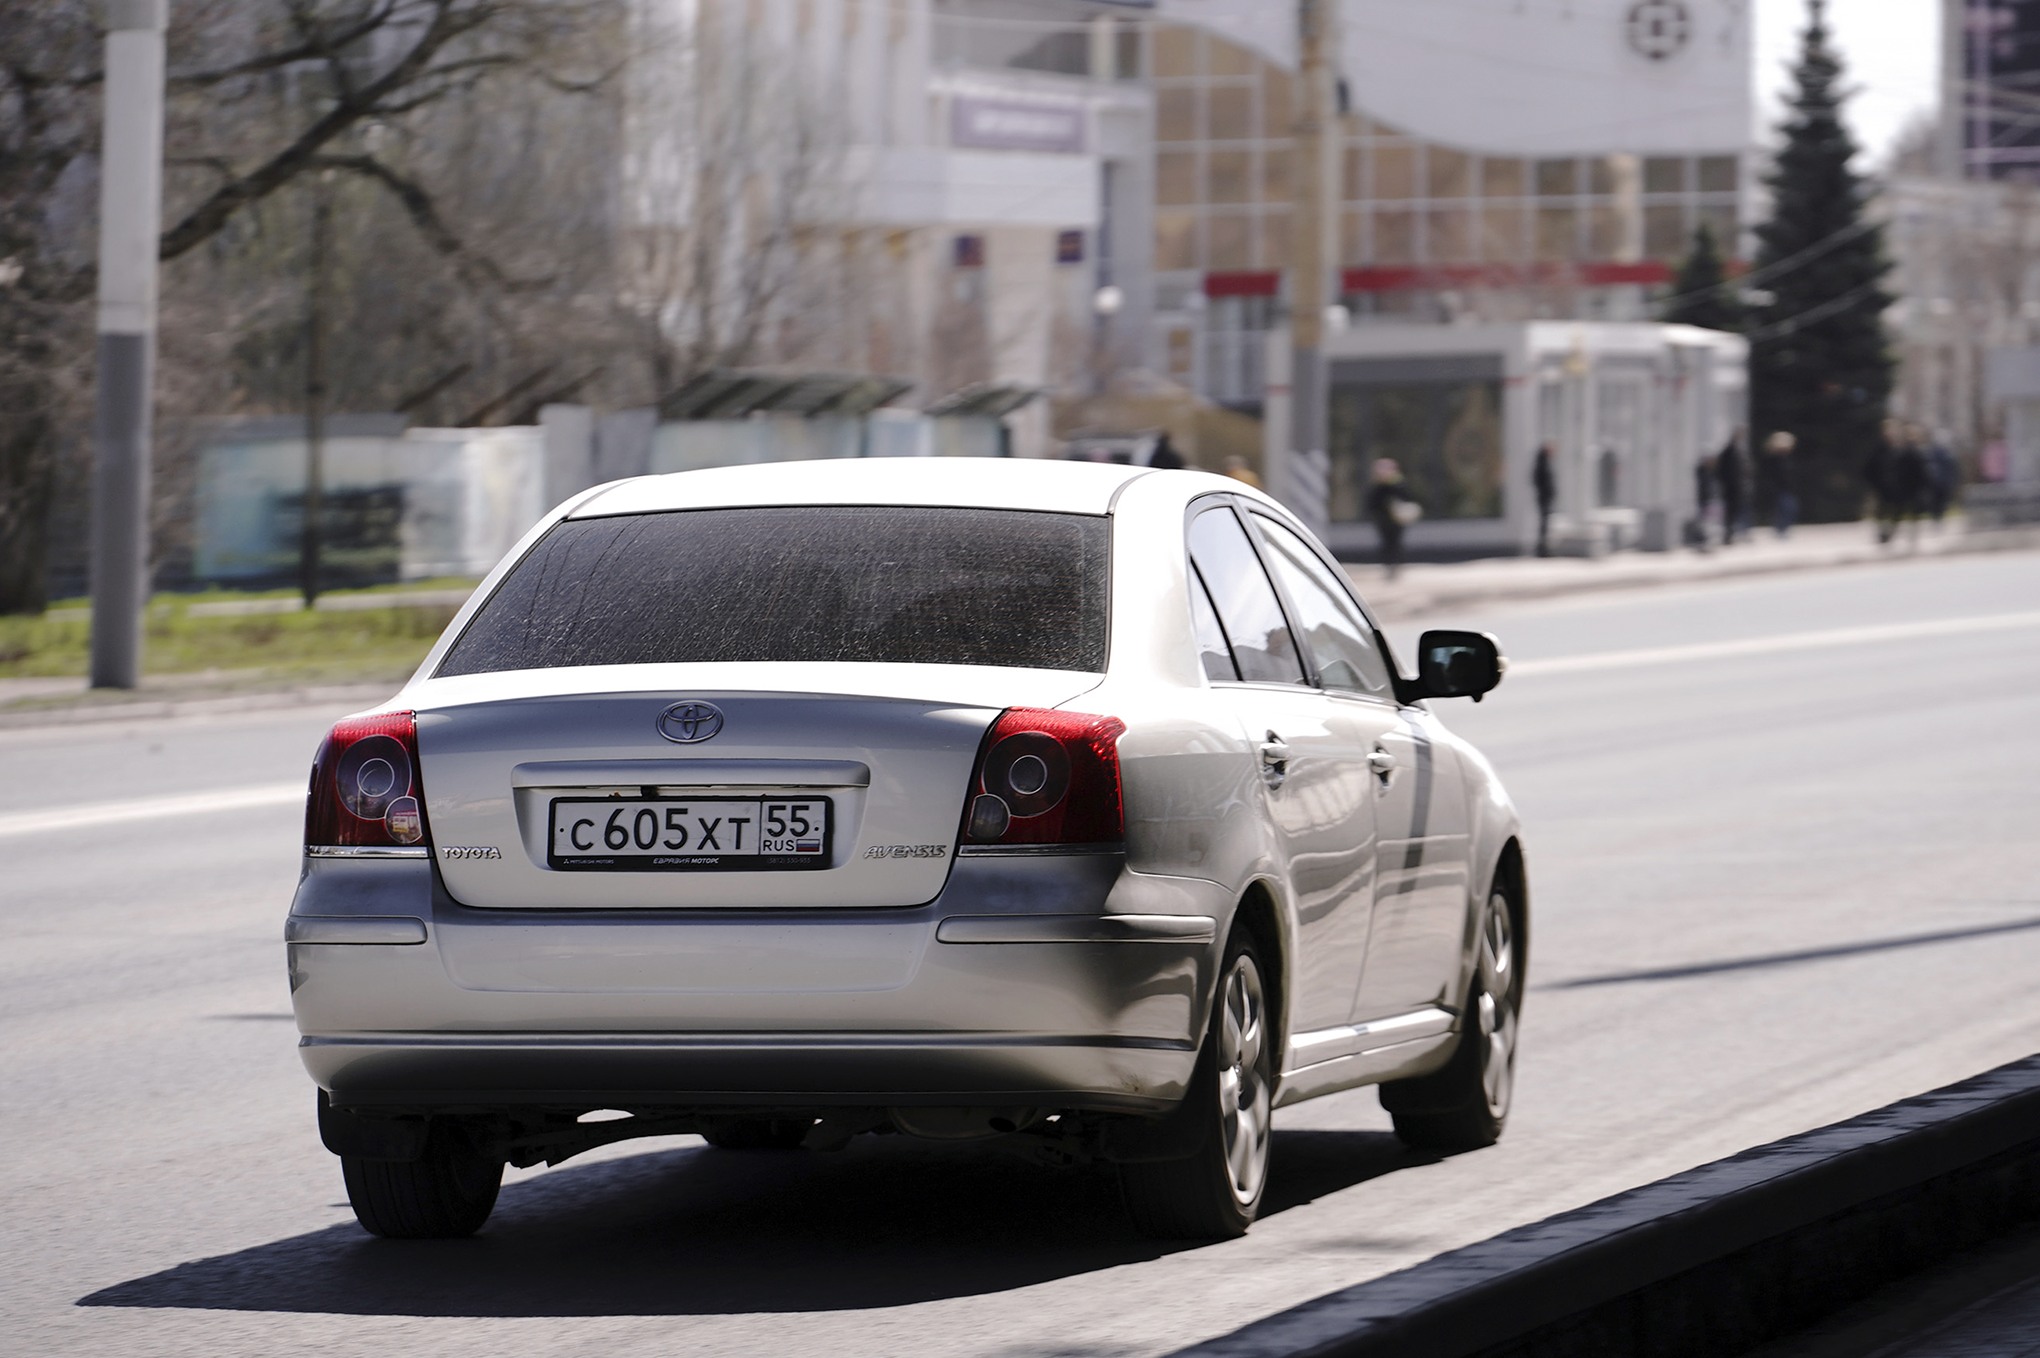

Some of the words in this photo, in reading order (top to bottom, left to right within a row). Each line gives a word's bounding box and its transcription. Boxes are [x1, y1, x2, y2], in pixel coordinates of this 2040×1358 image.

[766, 804, 810, 838] 55
[762, 839, 795, 852] RUS
[863, 844, 947, 859] AVENSIS
[441, 846, 502, 860] TOYOTA
